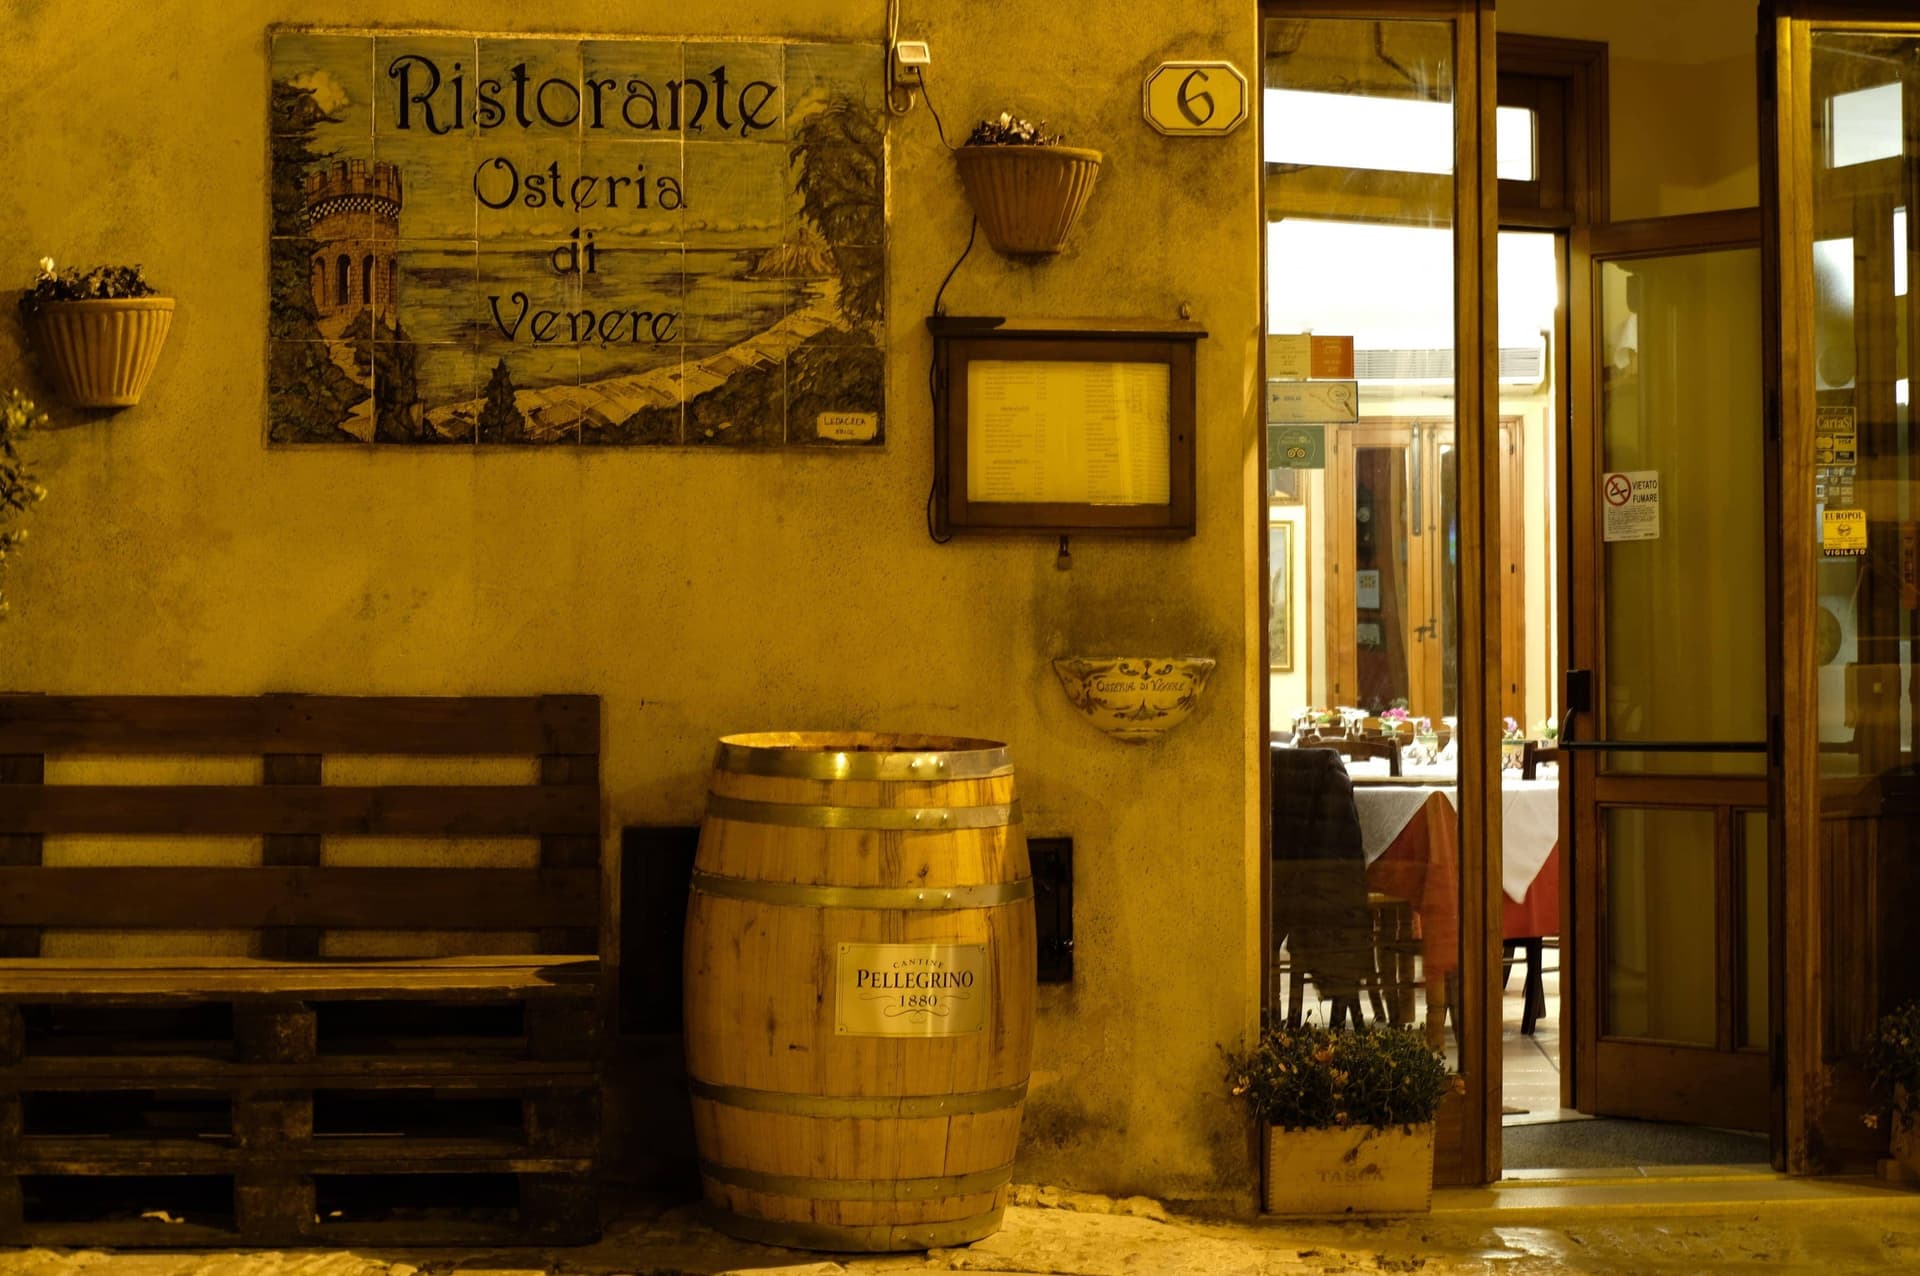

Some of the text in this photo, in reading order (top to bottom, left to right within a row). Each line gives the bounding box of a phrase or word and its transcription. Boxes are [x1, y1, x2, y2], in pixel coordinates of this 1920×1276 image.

[388, 54, 779, 137] Ristorante
[1177, 69, 1215, 127] 6
[472, 157, 689, 213] Osteria
[550, 228, 597, 275] di
[487, 291, 679, 349] Venere
[1632, 479, 1658, 490] VIETATO
[1632, 493, 1658, 503] FUMARE
[1825, 511, 1864, 520] EUROPOL
[893, 958, 944, 969] CANTINE
[856, 969, 974, 989] PELLEGRINO
[900, 994, 938, 1007] 1880
